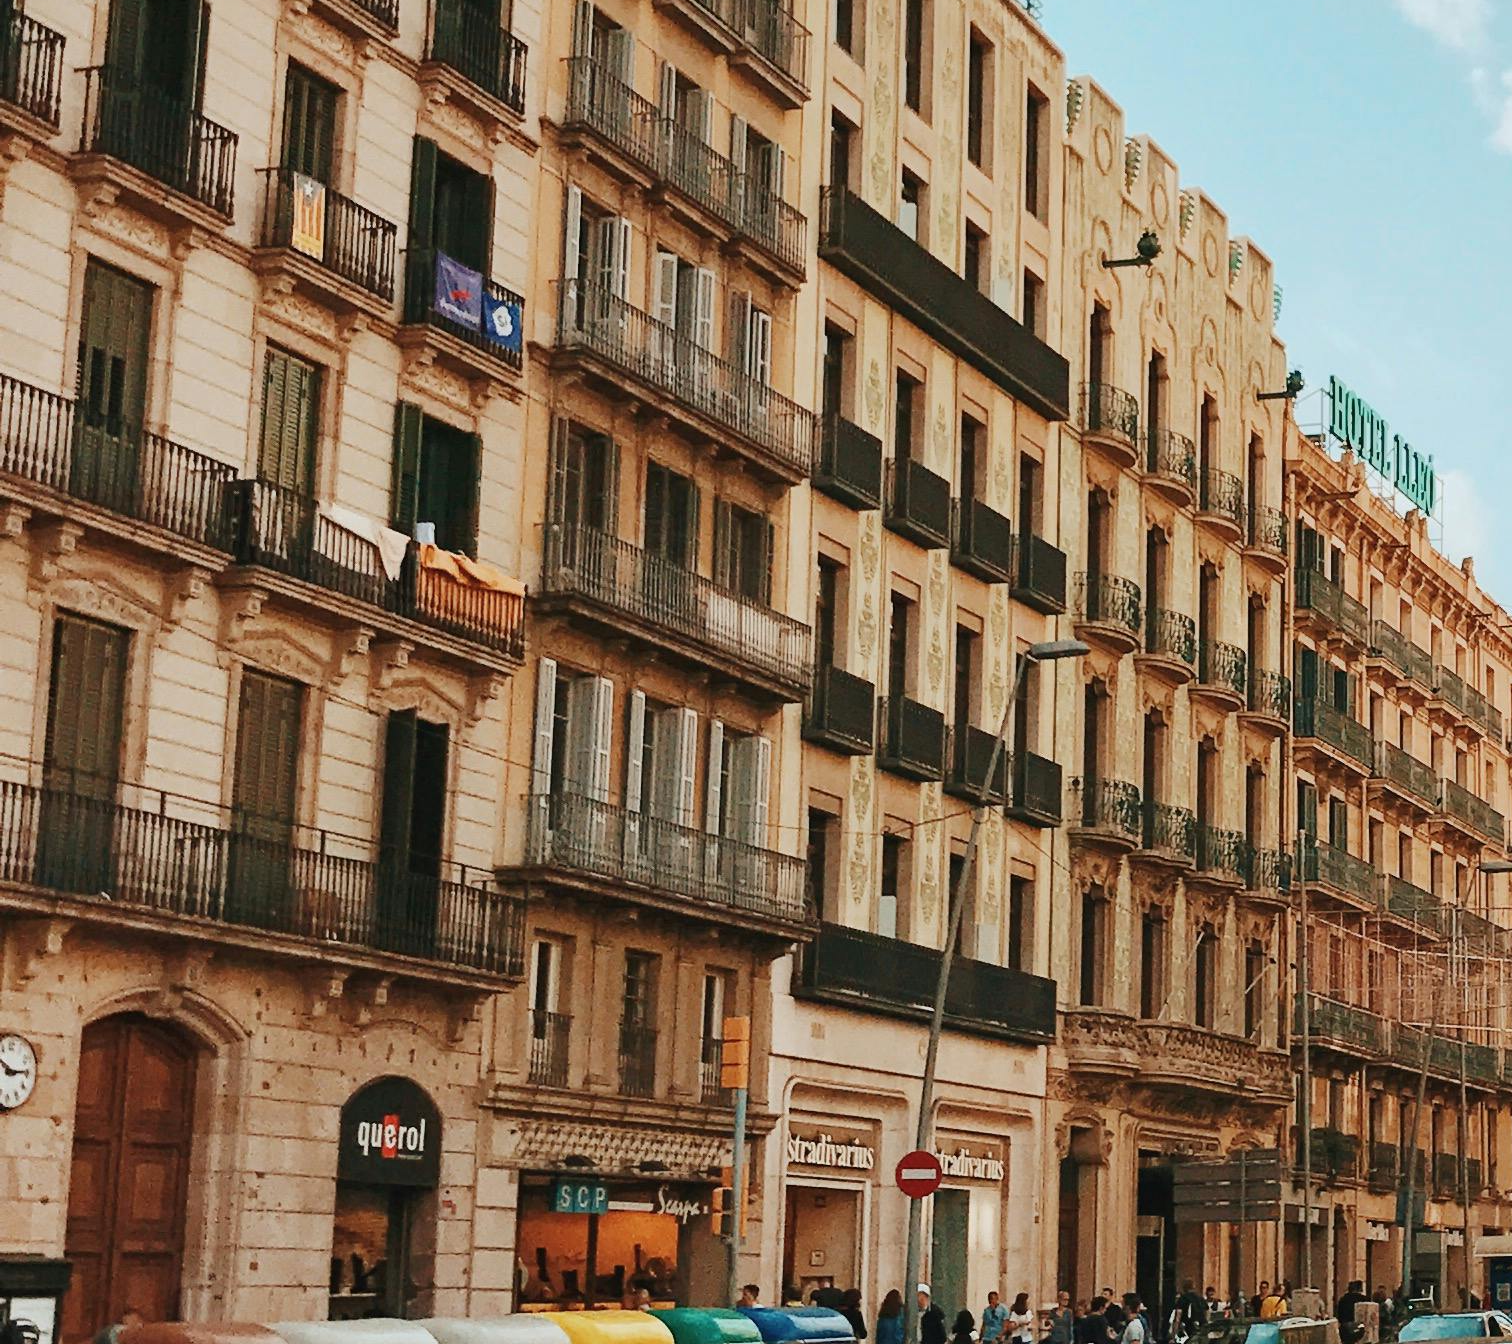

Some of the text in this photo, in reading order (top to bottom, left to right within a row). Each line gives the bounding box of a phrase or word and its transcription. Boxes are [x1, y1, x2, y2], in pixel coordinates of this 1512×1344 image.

[1329, 375, 1390, 481] HOTEL
[357, 1117, 426, 1157] querol
[788, 1133, 874, 1170] stradivarius
[936, 1147, 1005, 1181] tradivarius
[559, 1184, 607, 1208] SCP
